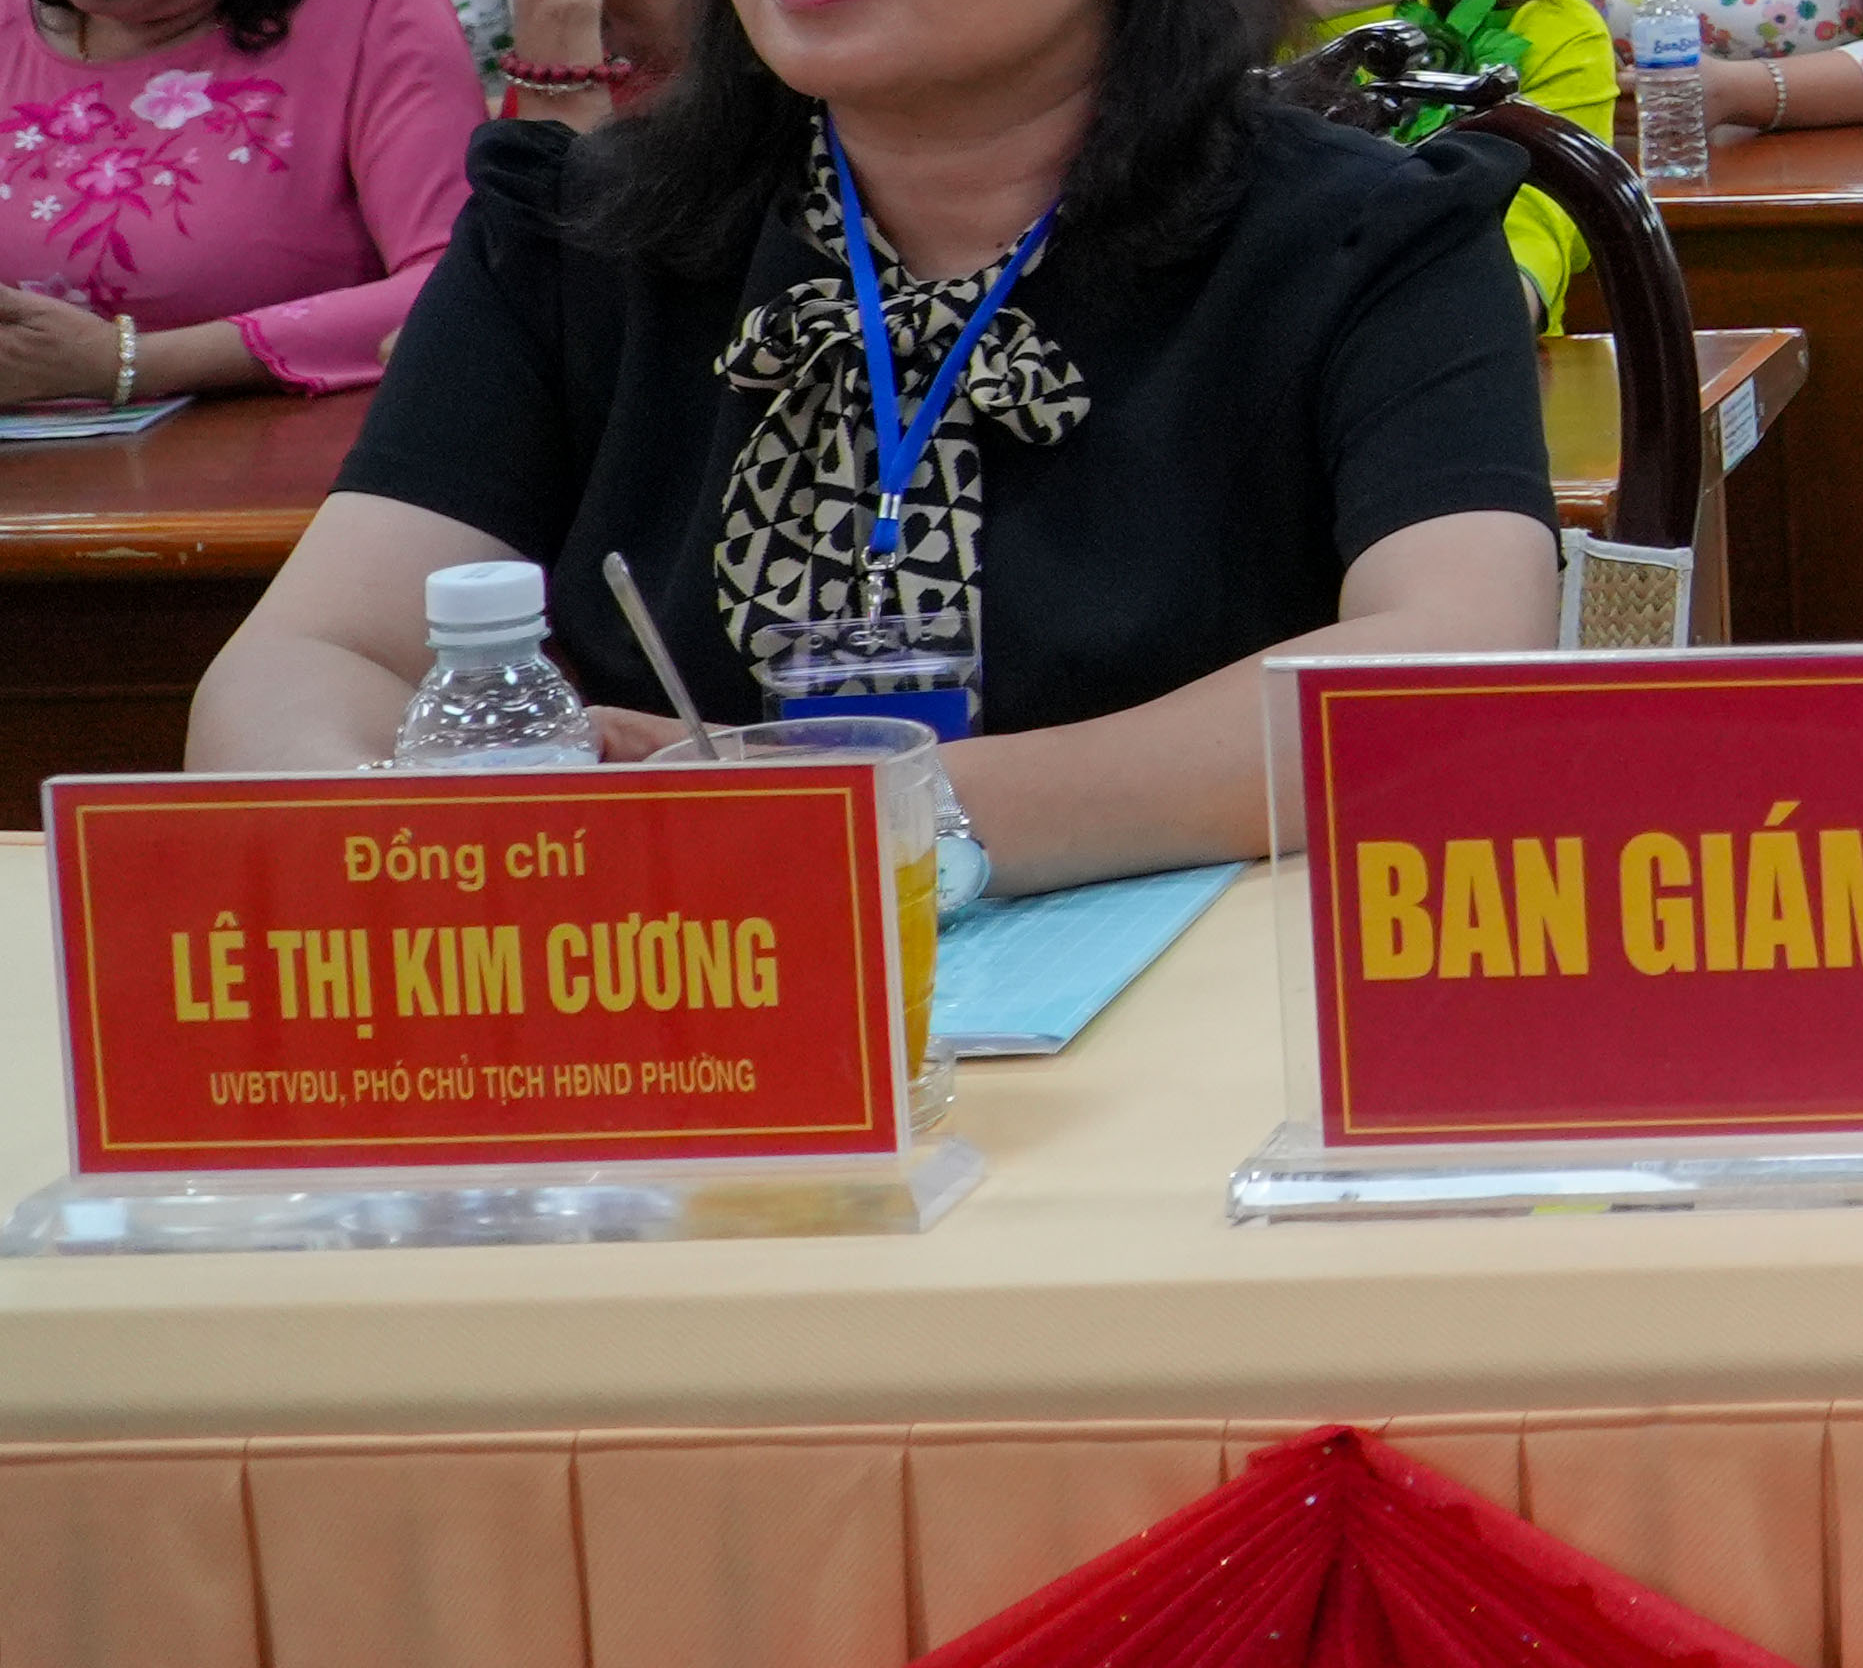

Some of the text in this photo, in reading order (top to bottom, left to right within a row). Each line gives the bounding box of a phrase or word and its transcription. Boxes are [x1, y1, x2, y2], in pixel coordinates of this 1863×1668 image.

[344, 827, 586, 892] Đồng chí
[1357, 837, 1589, 981] BAN
[172, 910, 779, 1039] LÊ THỊ KIM CƯƠNG
[210, 1052, 756, 1105] UVBTVĐU, PHÓ CHỦ TỊCH HĐND PHƯỜNG
